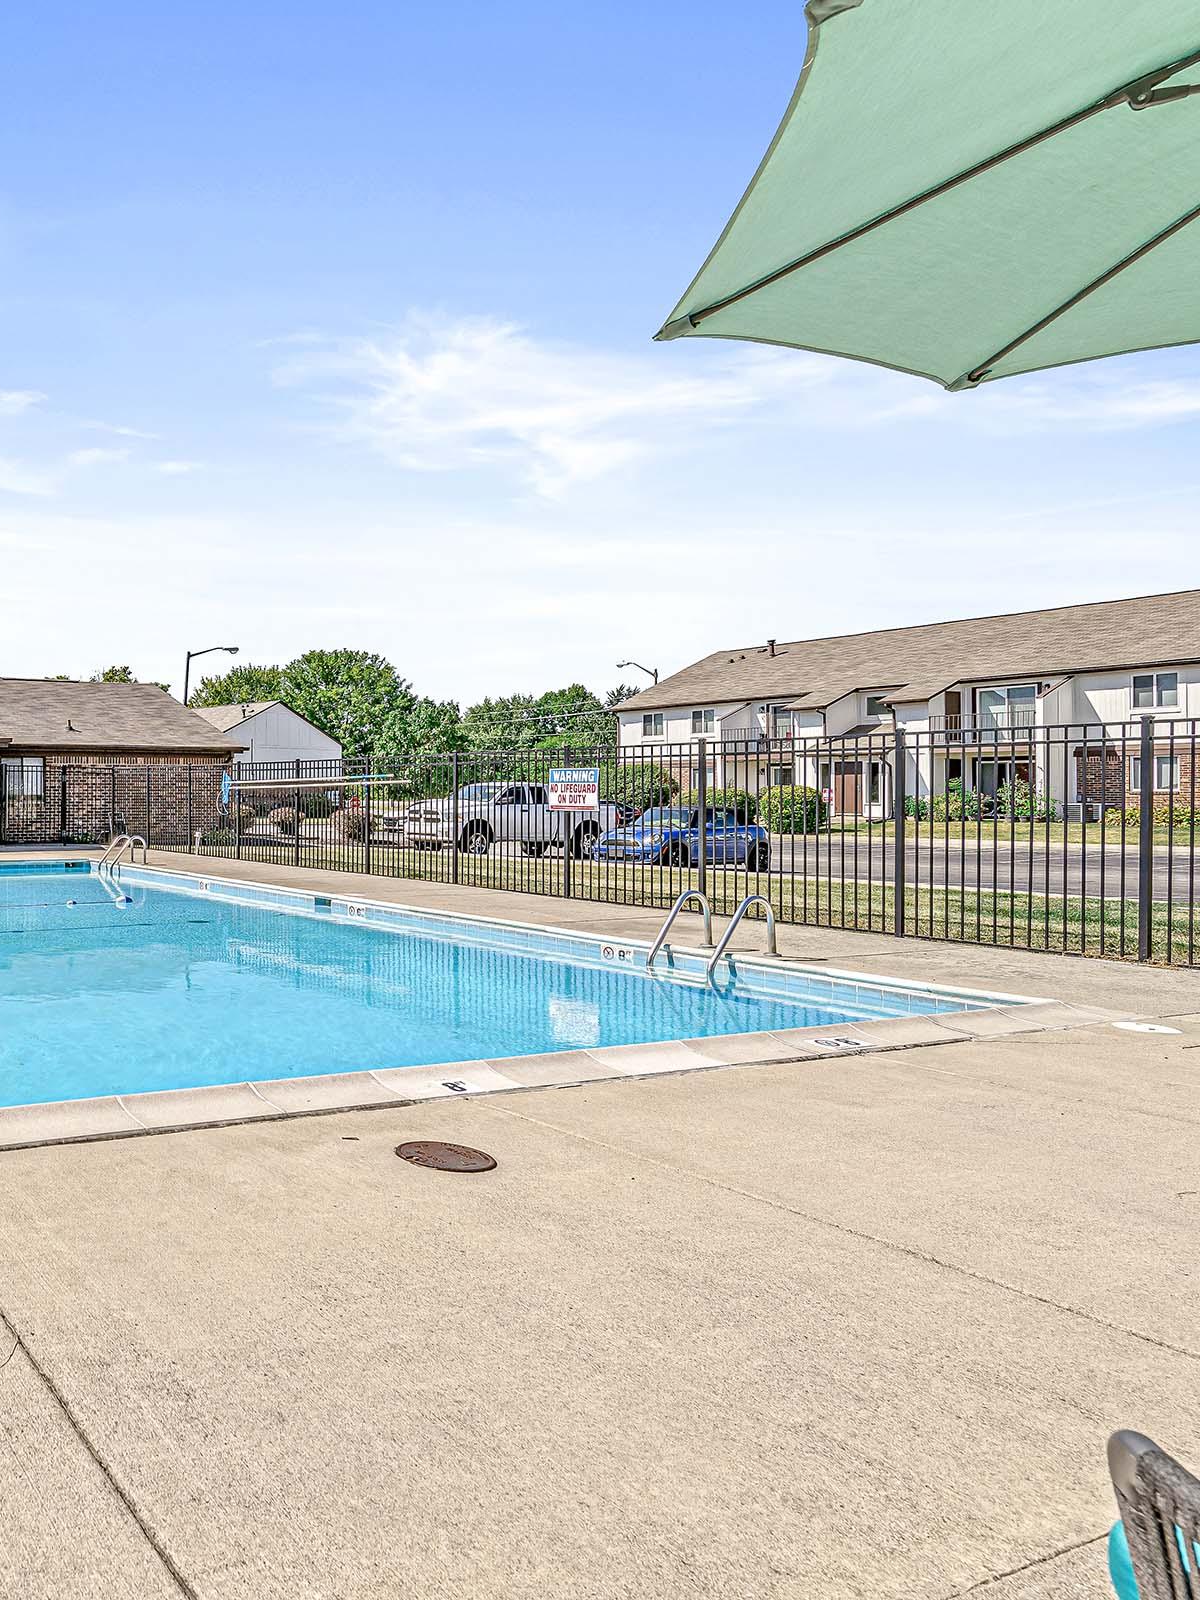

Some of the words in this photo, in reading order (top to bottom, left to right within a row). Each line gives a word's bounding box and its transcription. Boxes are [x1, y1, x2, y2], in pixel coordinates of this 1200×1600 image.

[553, 770, 595, 782] WARNING
[550, 784, 559, 793] NO
[561, 784, 596, 793] LIFEGUARD
[558, 794, 566, 804] ON
[569, 795, 587, 804] DUTY
[618, 950, 626, 961] 8
